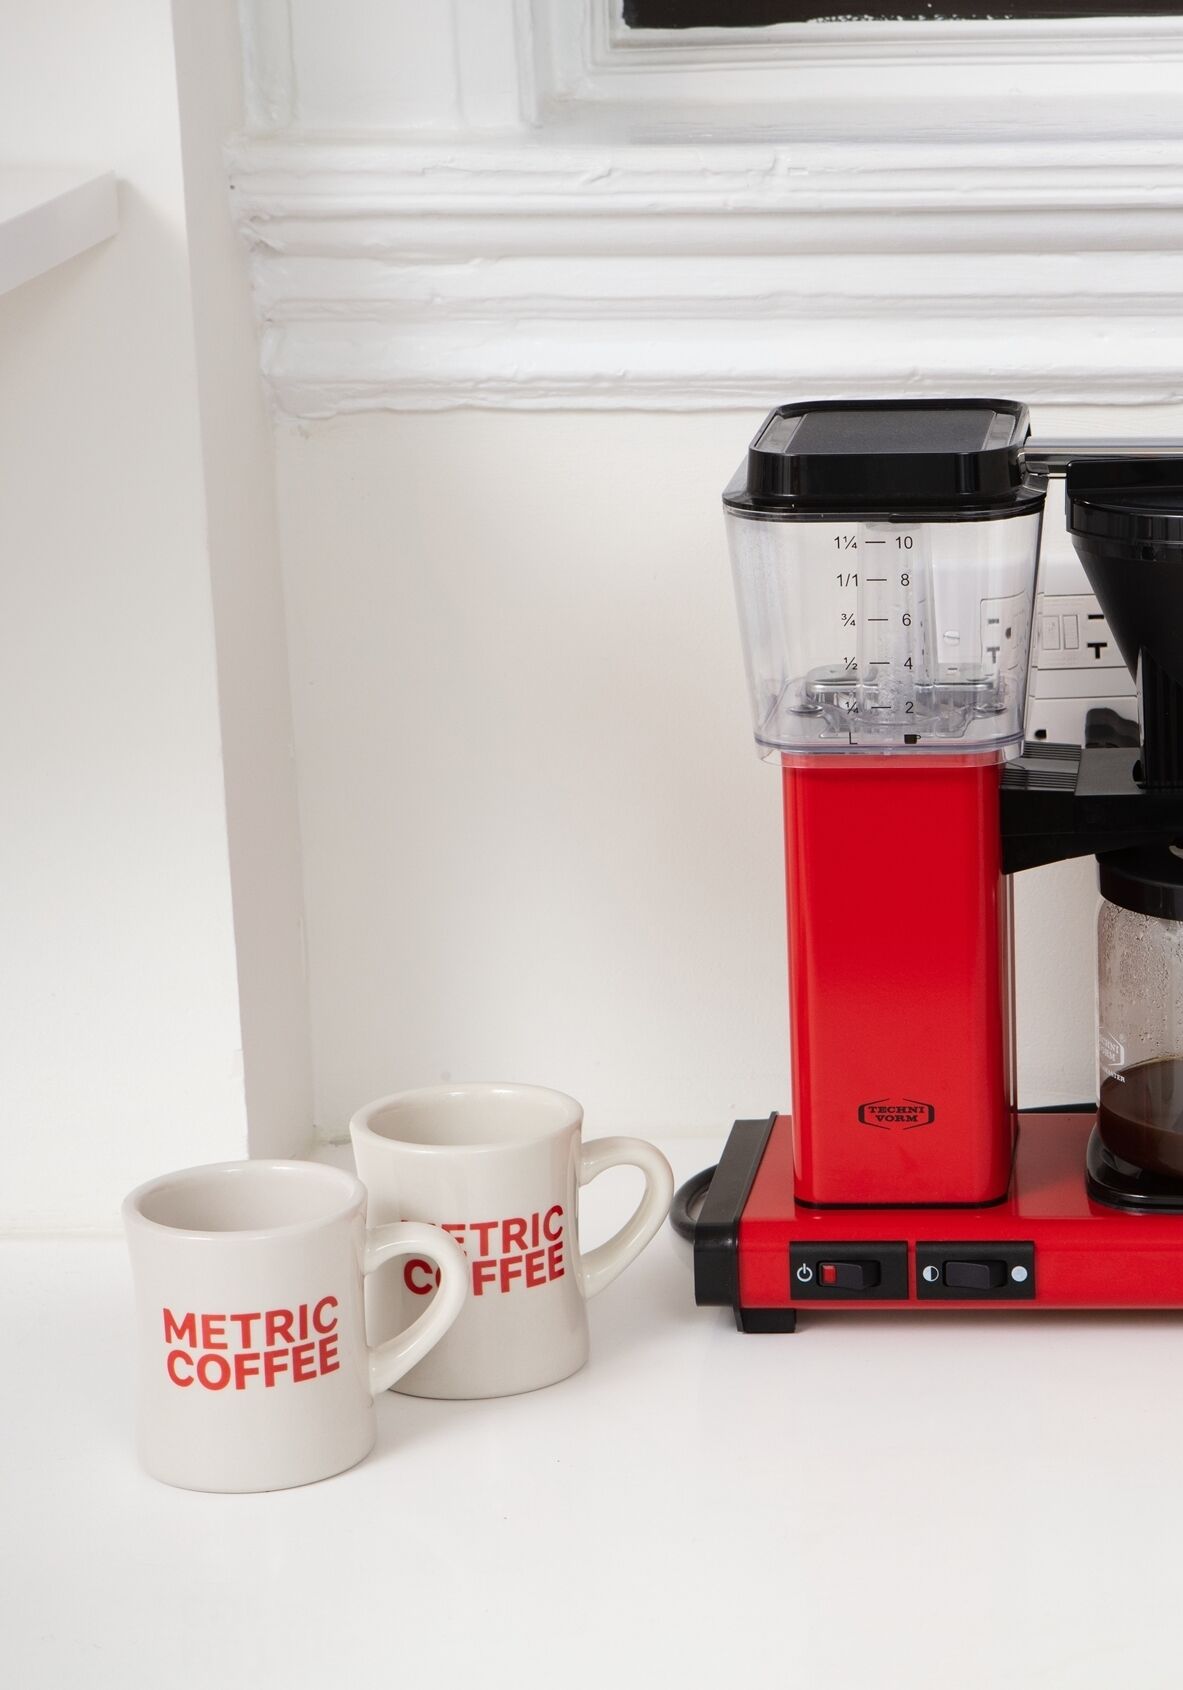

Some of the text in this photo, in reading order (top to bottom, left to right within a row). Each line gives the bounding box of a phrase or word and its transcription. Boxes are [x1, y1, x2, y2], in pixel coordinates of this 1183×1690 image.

[895, 536, 913, 549] 10
[836, 573, 910, 587] 1/1 8
[902, 613, 912, 627] 6
[903, 657, 913, 670] 4
[905, 701, 914, 714] 2
[848, 731, 858, 744] L
[868, 1106, 925, 1114] TECHNI
[875, 1114, 918, 1122] VORM
[401, 1205, 564, 1257] TRIC
[403, 1241, 565, 1296] CFFEE
[162, 1296, 339, 1350] METRIC
[166, 1333, 340, 1391] COFFEE
